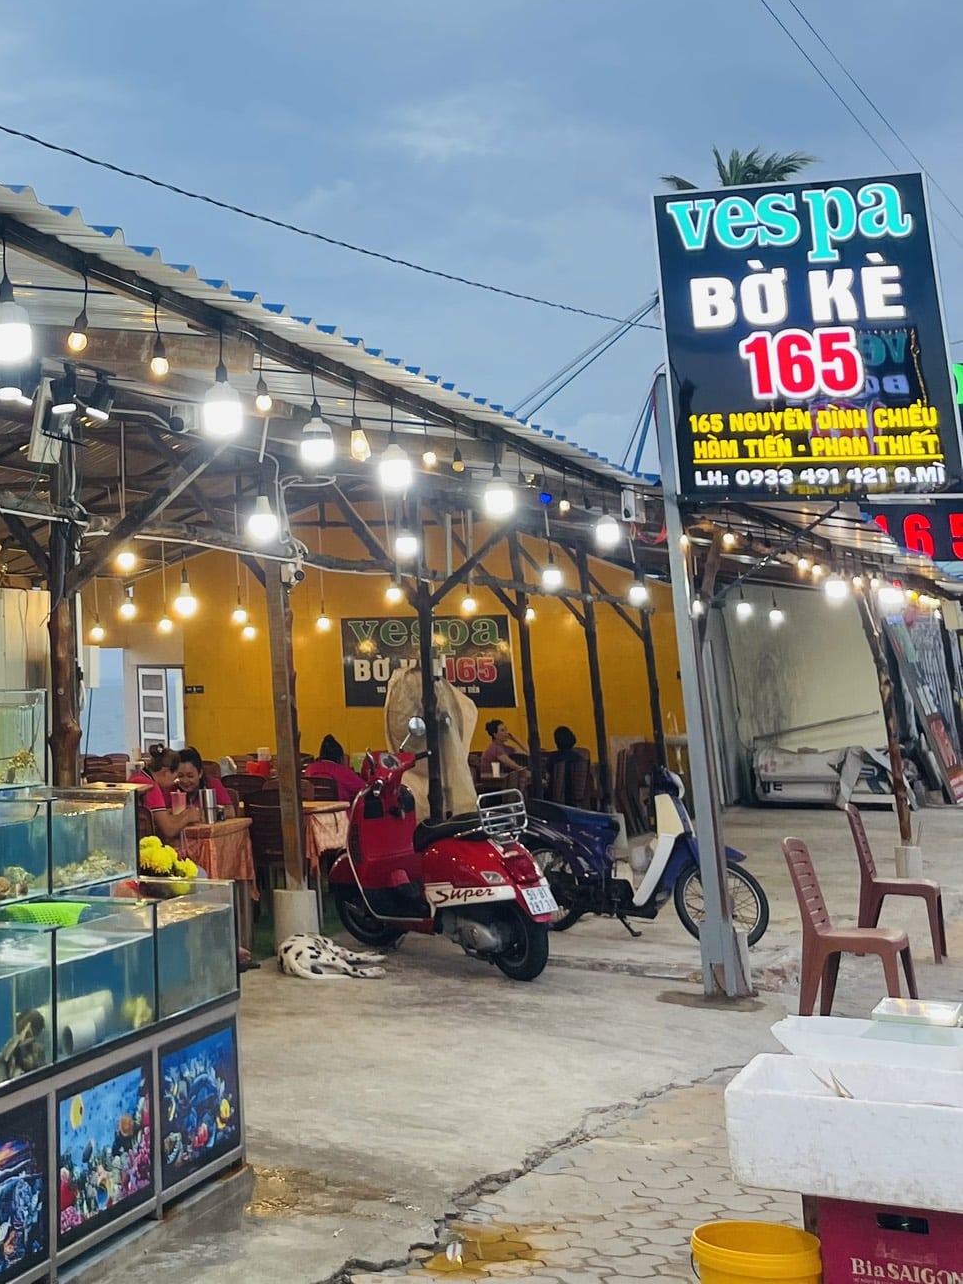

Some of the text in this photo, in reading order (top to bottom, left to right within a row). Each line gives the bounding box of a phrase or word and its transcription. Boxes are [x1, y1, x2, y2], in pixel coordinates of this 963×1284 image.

[666, 181, 913, 264] vespa
[688, 251, 907, 330] BỜ KÈ
[739, 326, 866, 400] 165
[688, 413, 724, 433] 165
[693, 433, 739, 459] HÀM
[743, 432, 793, 458] TIẾN
[811, 436, 870, 457] PHAN
[872, 428, 939, 456] THIẾT
[694, 470, 730, 487] LH:
[734, 468, 794, 486] 0933
[800, 468, 839, 485] 491
[846, 467, 887, 484] 421
[445, 656, 498, 683] 165
[434, 887, 496, 904] Super
[850, 1257, 886, 1278] Bia
